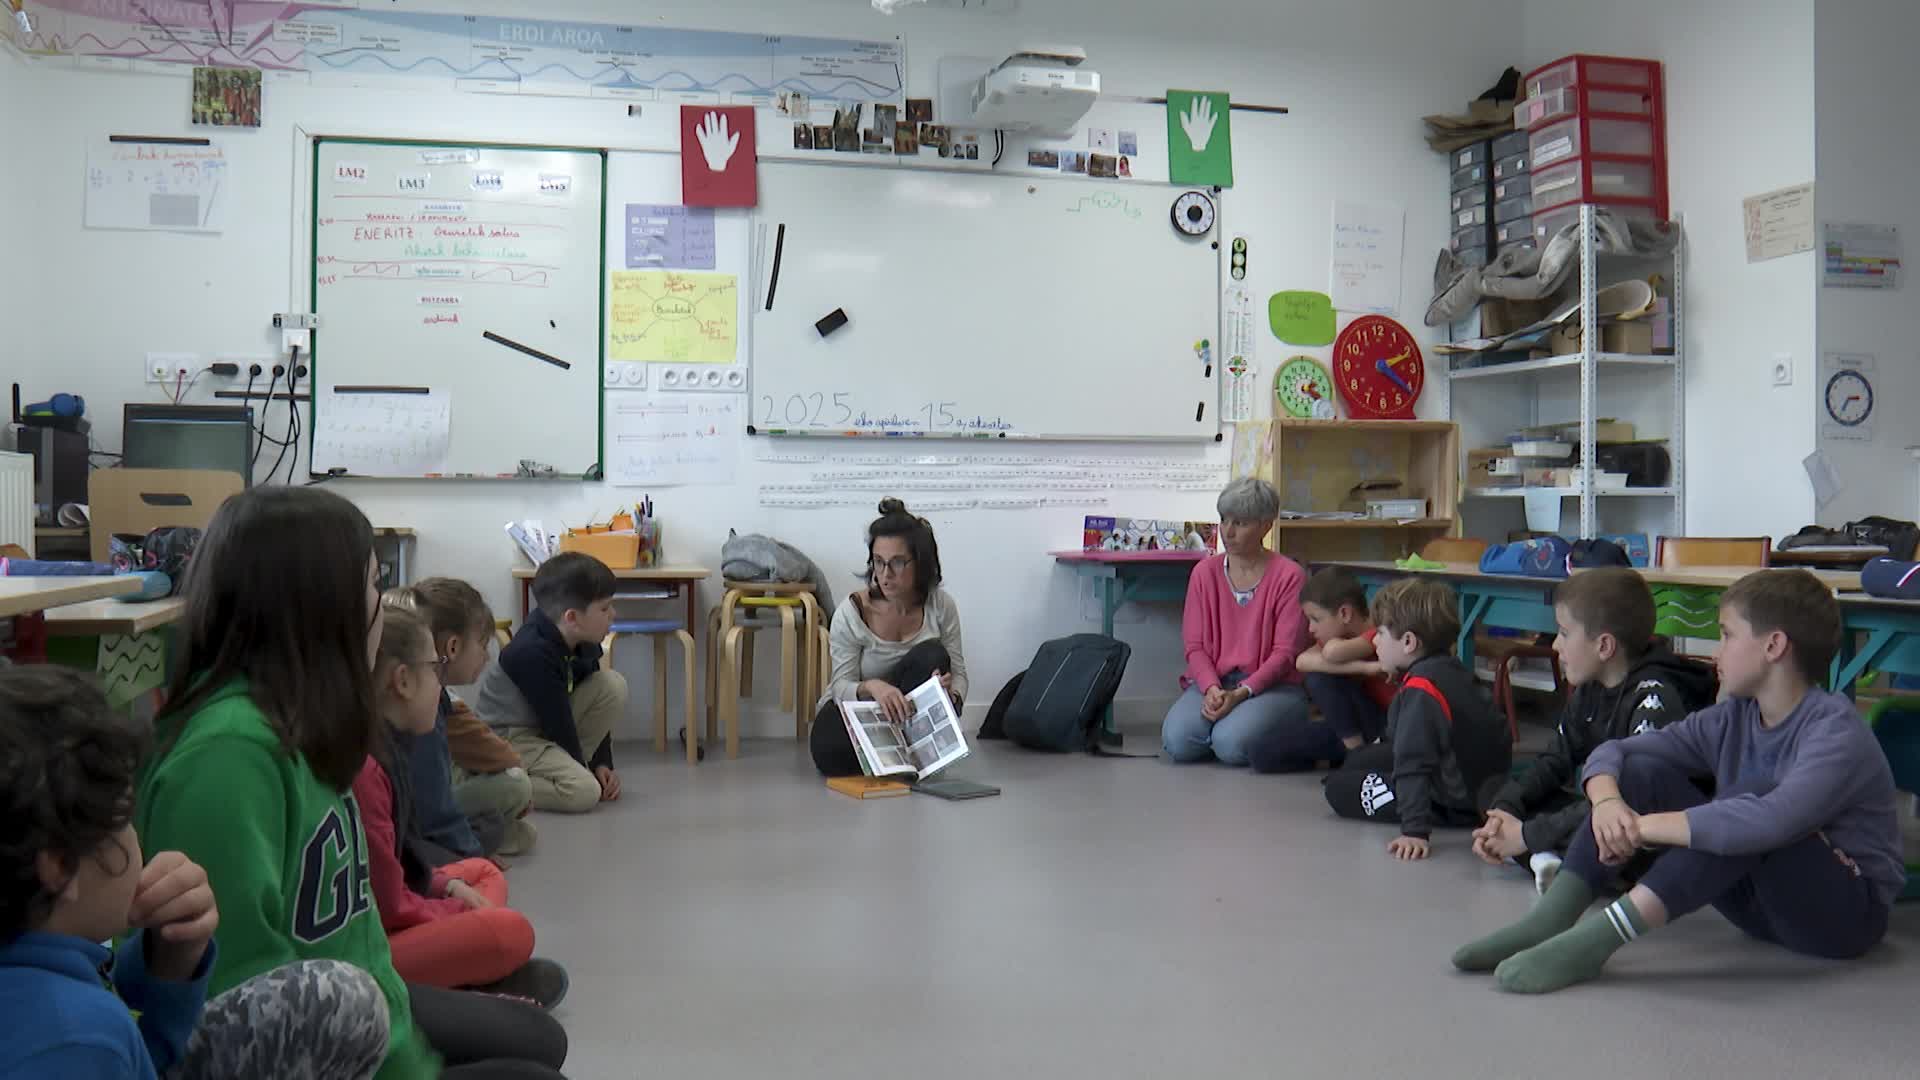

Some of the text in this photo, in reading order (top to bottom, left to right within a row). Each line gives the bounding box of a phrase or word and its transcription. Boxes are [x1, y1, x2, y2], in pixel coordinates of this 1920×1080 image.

[500, 23, 605, 47] ERDI AROA
[339, 167, 365, 178] LM2
[399, 179, 425, 189] LM3
[1356, 329, 1369, 343] 11
[1372, 325, 1385, 336] 12
[1347, 343, 1360, 355] 10
[1343, 359, 1351, 372] 9
[1409, 362, 1417, 374] 3
[1350, 378, 1359, 391] 8
[1364, 392, 1371, 404] 7
[1379, 397, 1387, 410] 6
[1395, 393, 1402, 405] 5
[762, 391, 852, 427] 2025
[919, 401, 957, 431] 15
